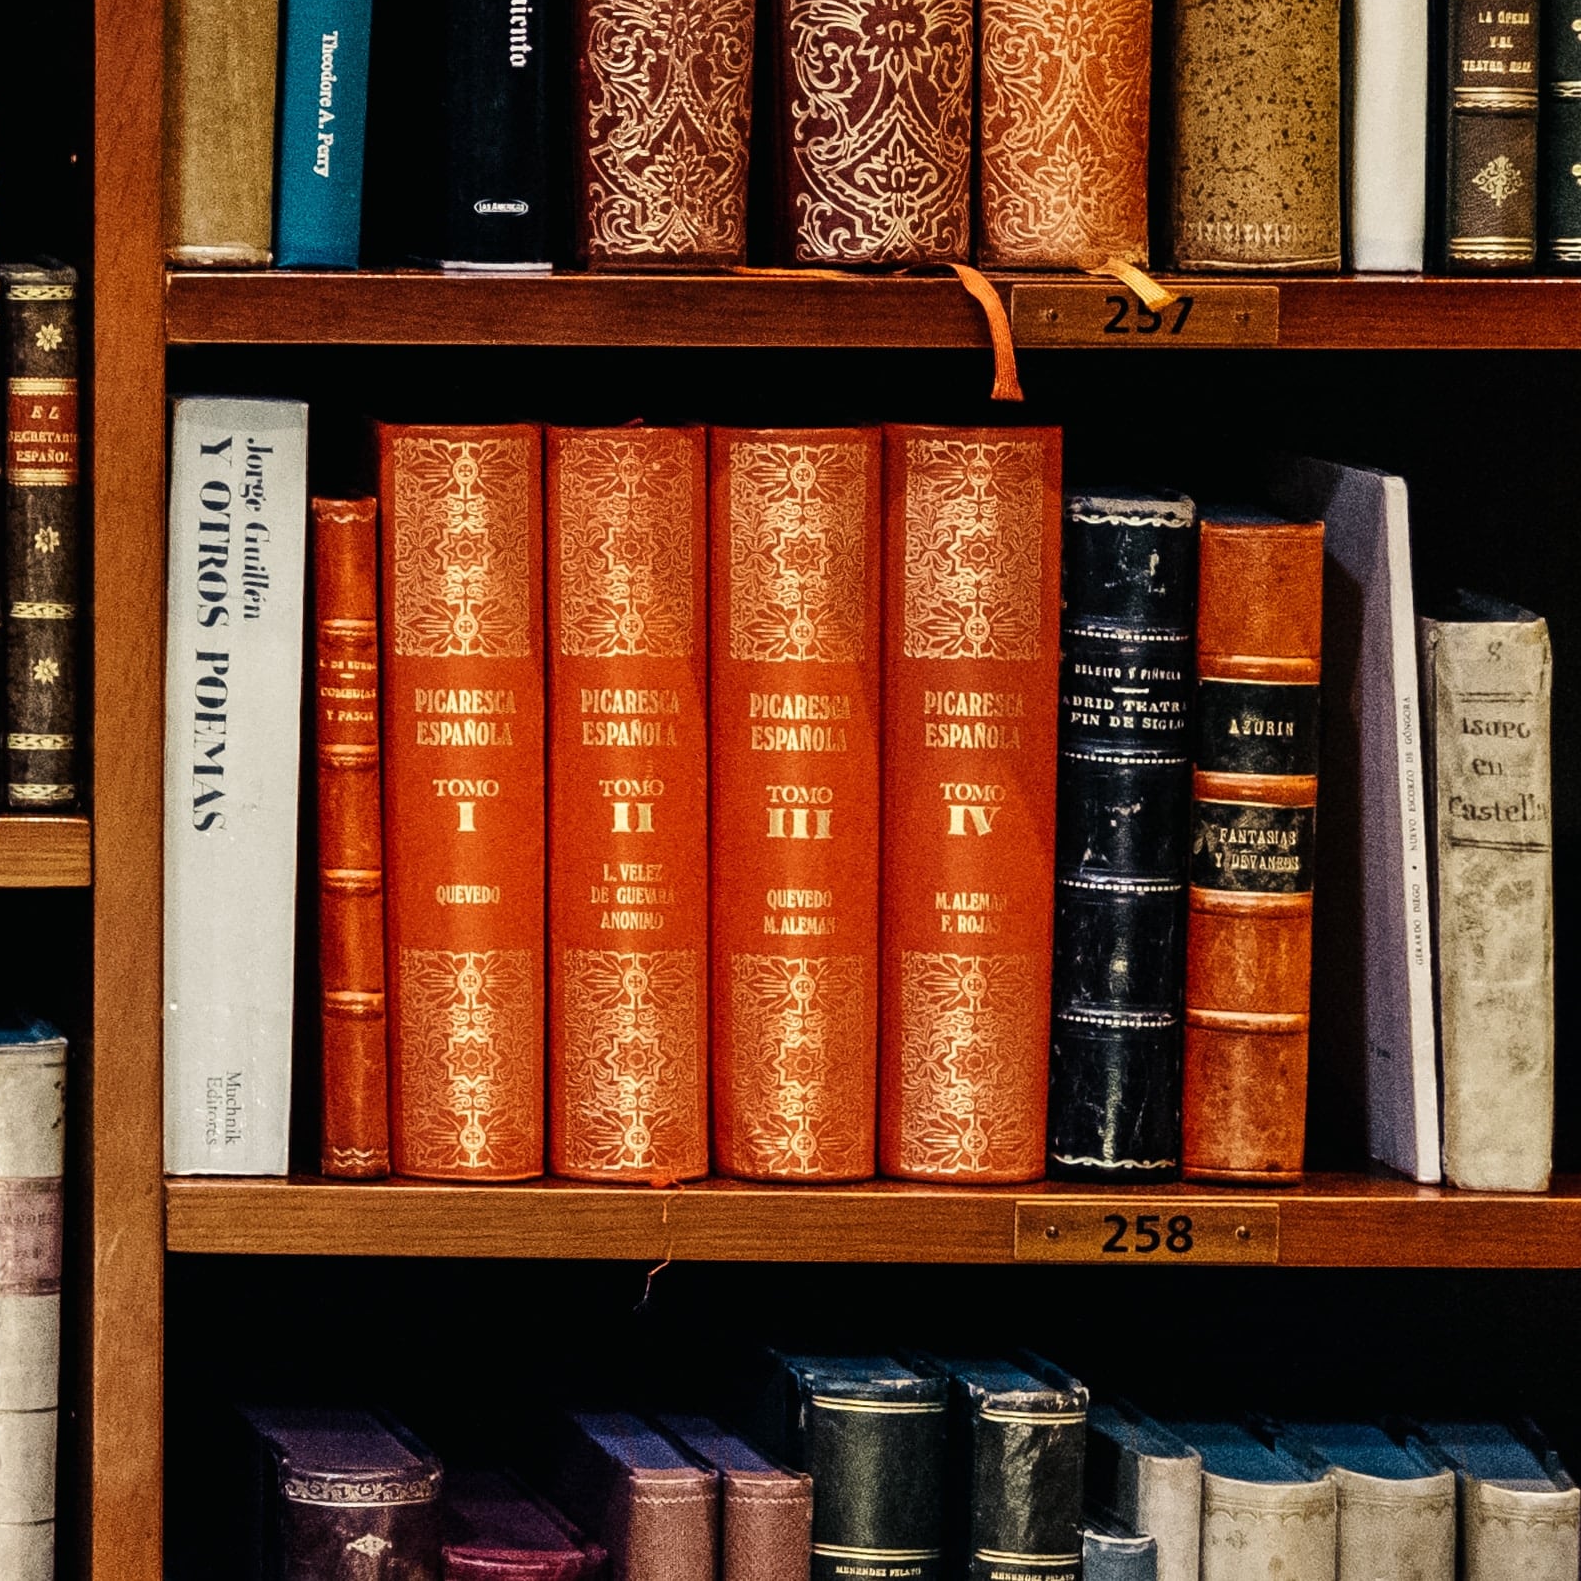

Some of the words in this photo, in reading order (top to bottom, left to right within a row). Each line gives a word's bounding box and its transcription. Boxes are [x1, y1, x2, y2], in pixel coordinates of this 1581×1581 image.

[319, 30, 339, 108] Theodore
[318, 108, 335, 129] A.
[313, 133, 334, 178] Perry
[199, 436, 234, 467] Y
[238, 437, 274, 513] Jorge
[196, 479, 233, 629] OTROS
[242, 521, 271, 622] Guillén
[415, 689, 517, 715] PICARESCA
[749, 692, 851, 720] PICARESCA
[191, 647, 231, 833] POEMAS
[416, 719, 514, 746] ESPAÑOLA
[751, 724, 847, 752] ESPAÑOLA
[433, 779, 499, 797] TOMO
[765, 785, 834, 804] TOMO
[766, 807, 834, 840] III
[1219, 828, 1297, 846] FANTASIAS
[437, 885, 501, 906] QUEVEDO
[766, 889, 832, 909] QUEVEDO
[206, 1077, 224, 1147] Editores
[225, 1071, 243, 1145] Muchnik
[1103, 1214, 1195, 1254] 258
